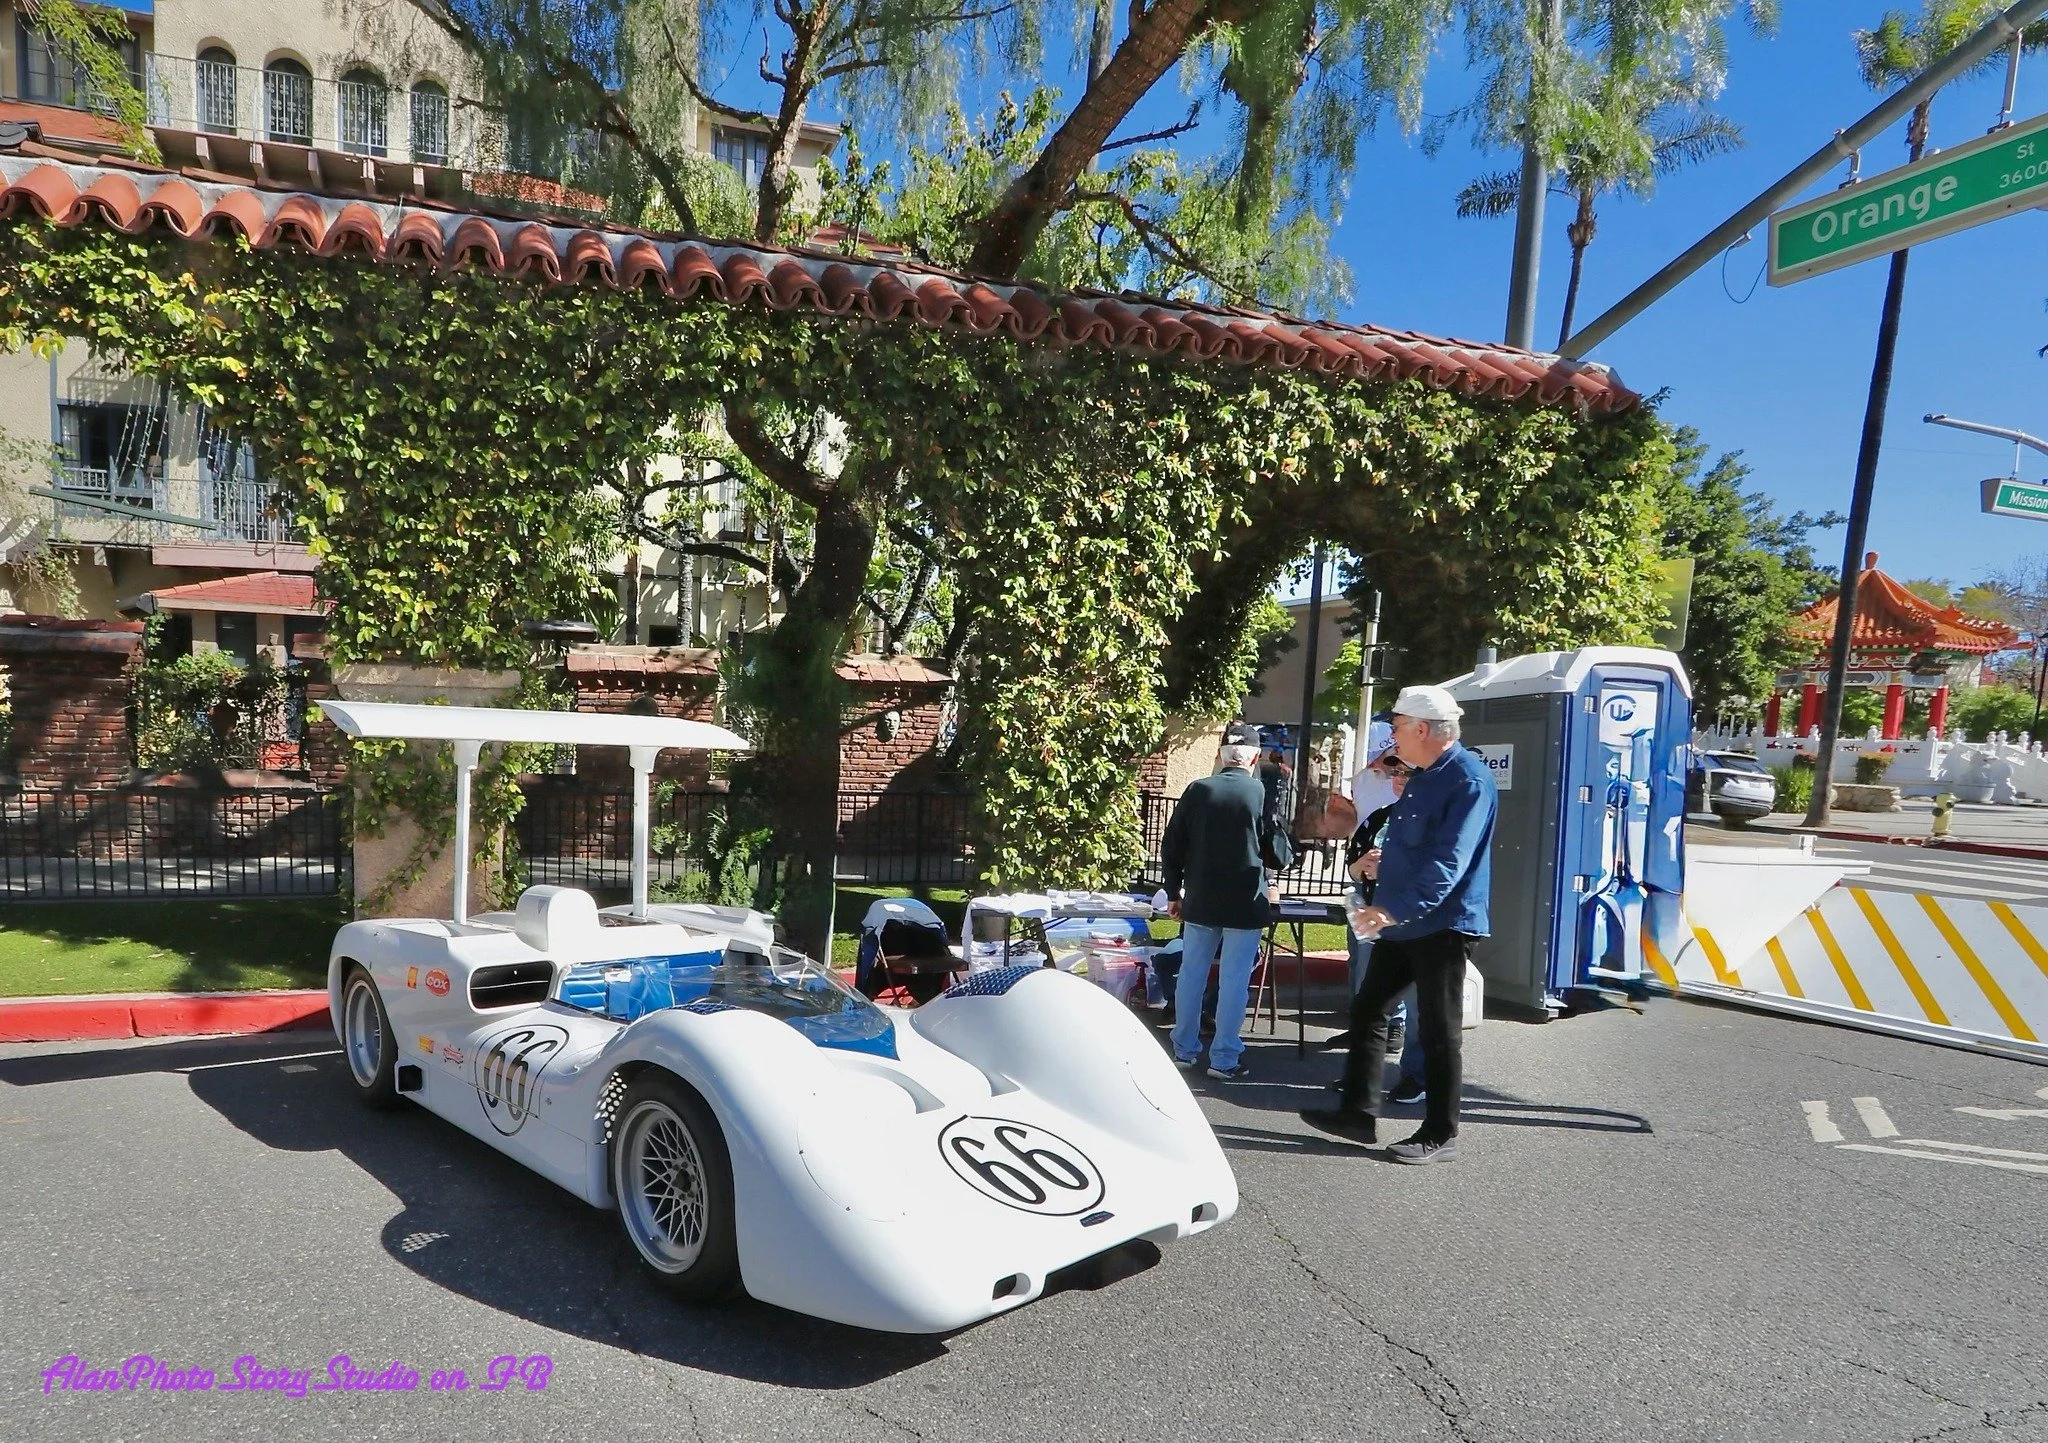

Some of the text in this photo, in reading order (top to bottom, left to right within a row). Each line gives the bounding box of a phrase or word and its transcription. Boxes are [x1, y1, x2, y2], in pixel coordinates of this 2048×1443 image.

[1999, 160, 2048, 188] 3600
[2016, 142, 2035, 159] St
[1811, 175, 1959, 243] Orange
[2009, 490, 2048, 509] Mission
[483, 1031, 558, 1121] 66
[951, 1126, 1089, 1205] 66
